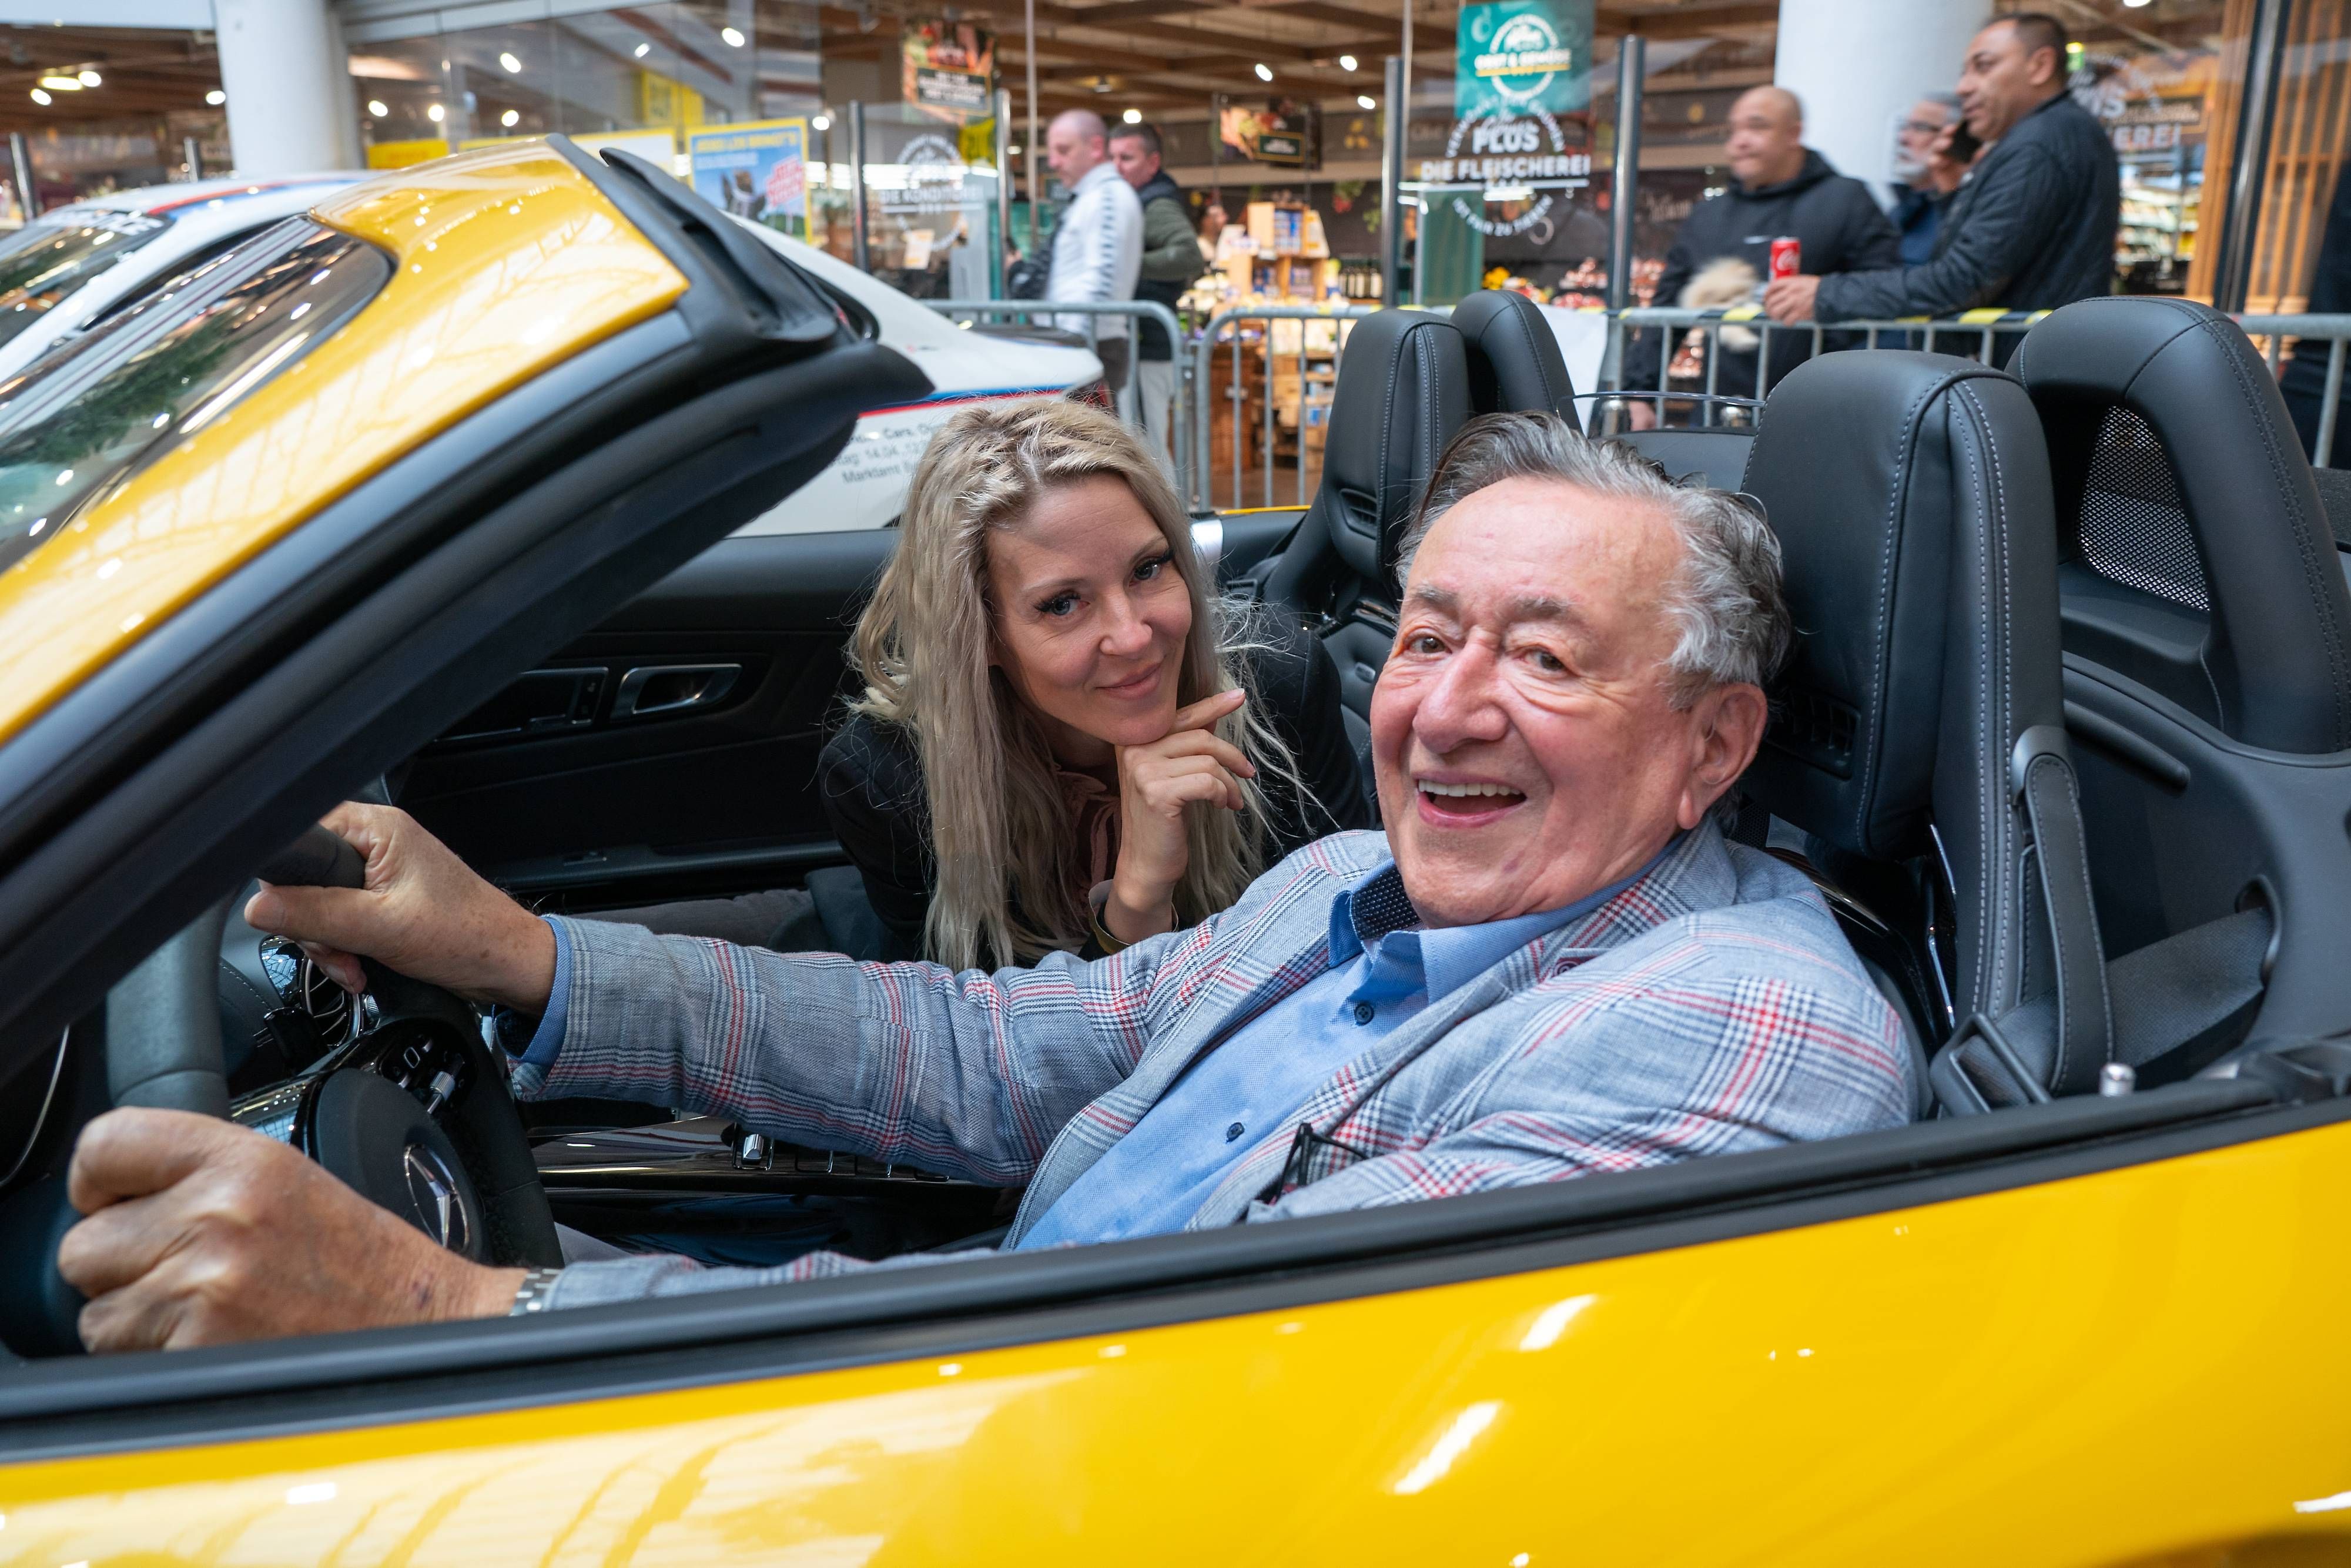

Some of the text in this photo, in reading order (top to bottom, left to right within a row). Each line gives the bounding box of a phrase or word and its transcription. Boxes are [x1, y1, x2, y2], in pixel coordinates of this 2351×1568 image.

[1472, 122, 1540, 154] PLUS
[2109, 123, 2181, 152] EREI
[1421, 154, 1591, 180] DIE FLEISCHEREI
